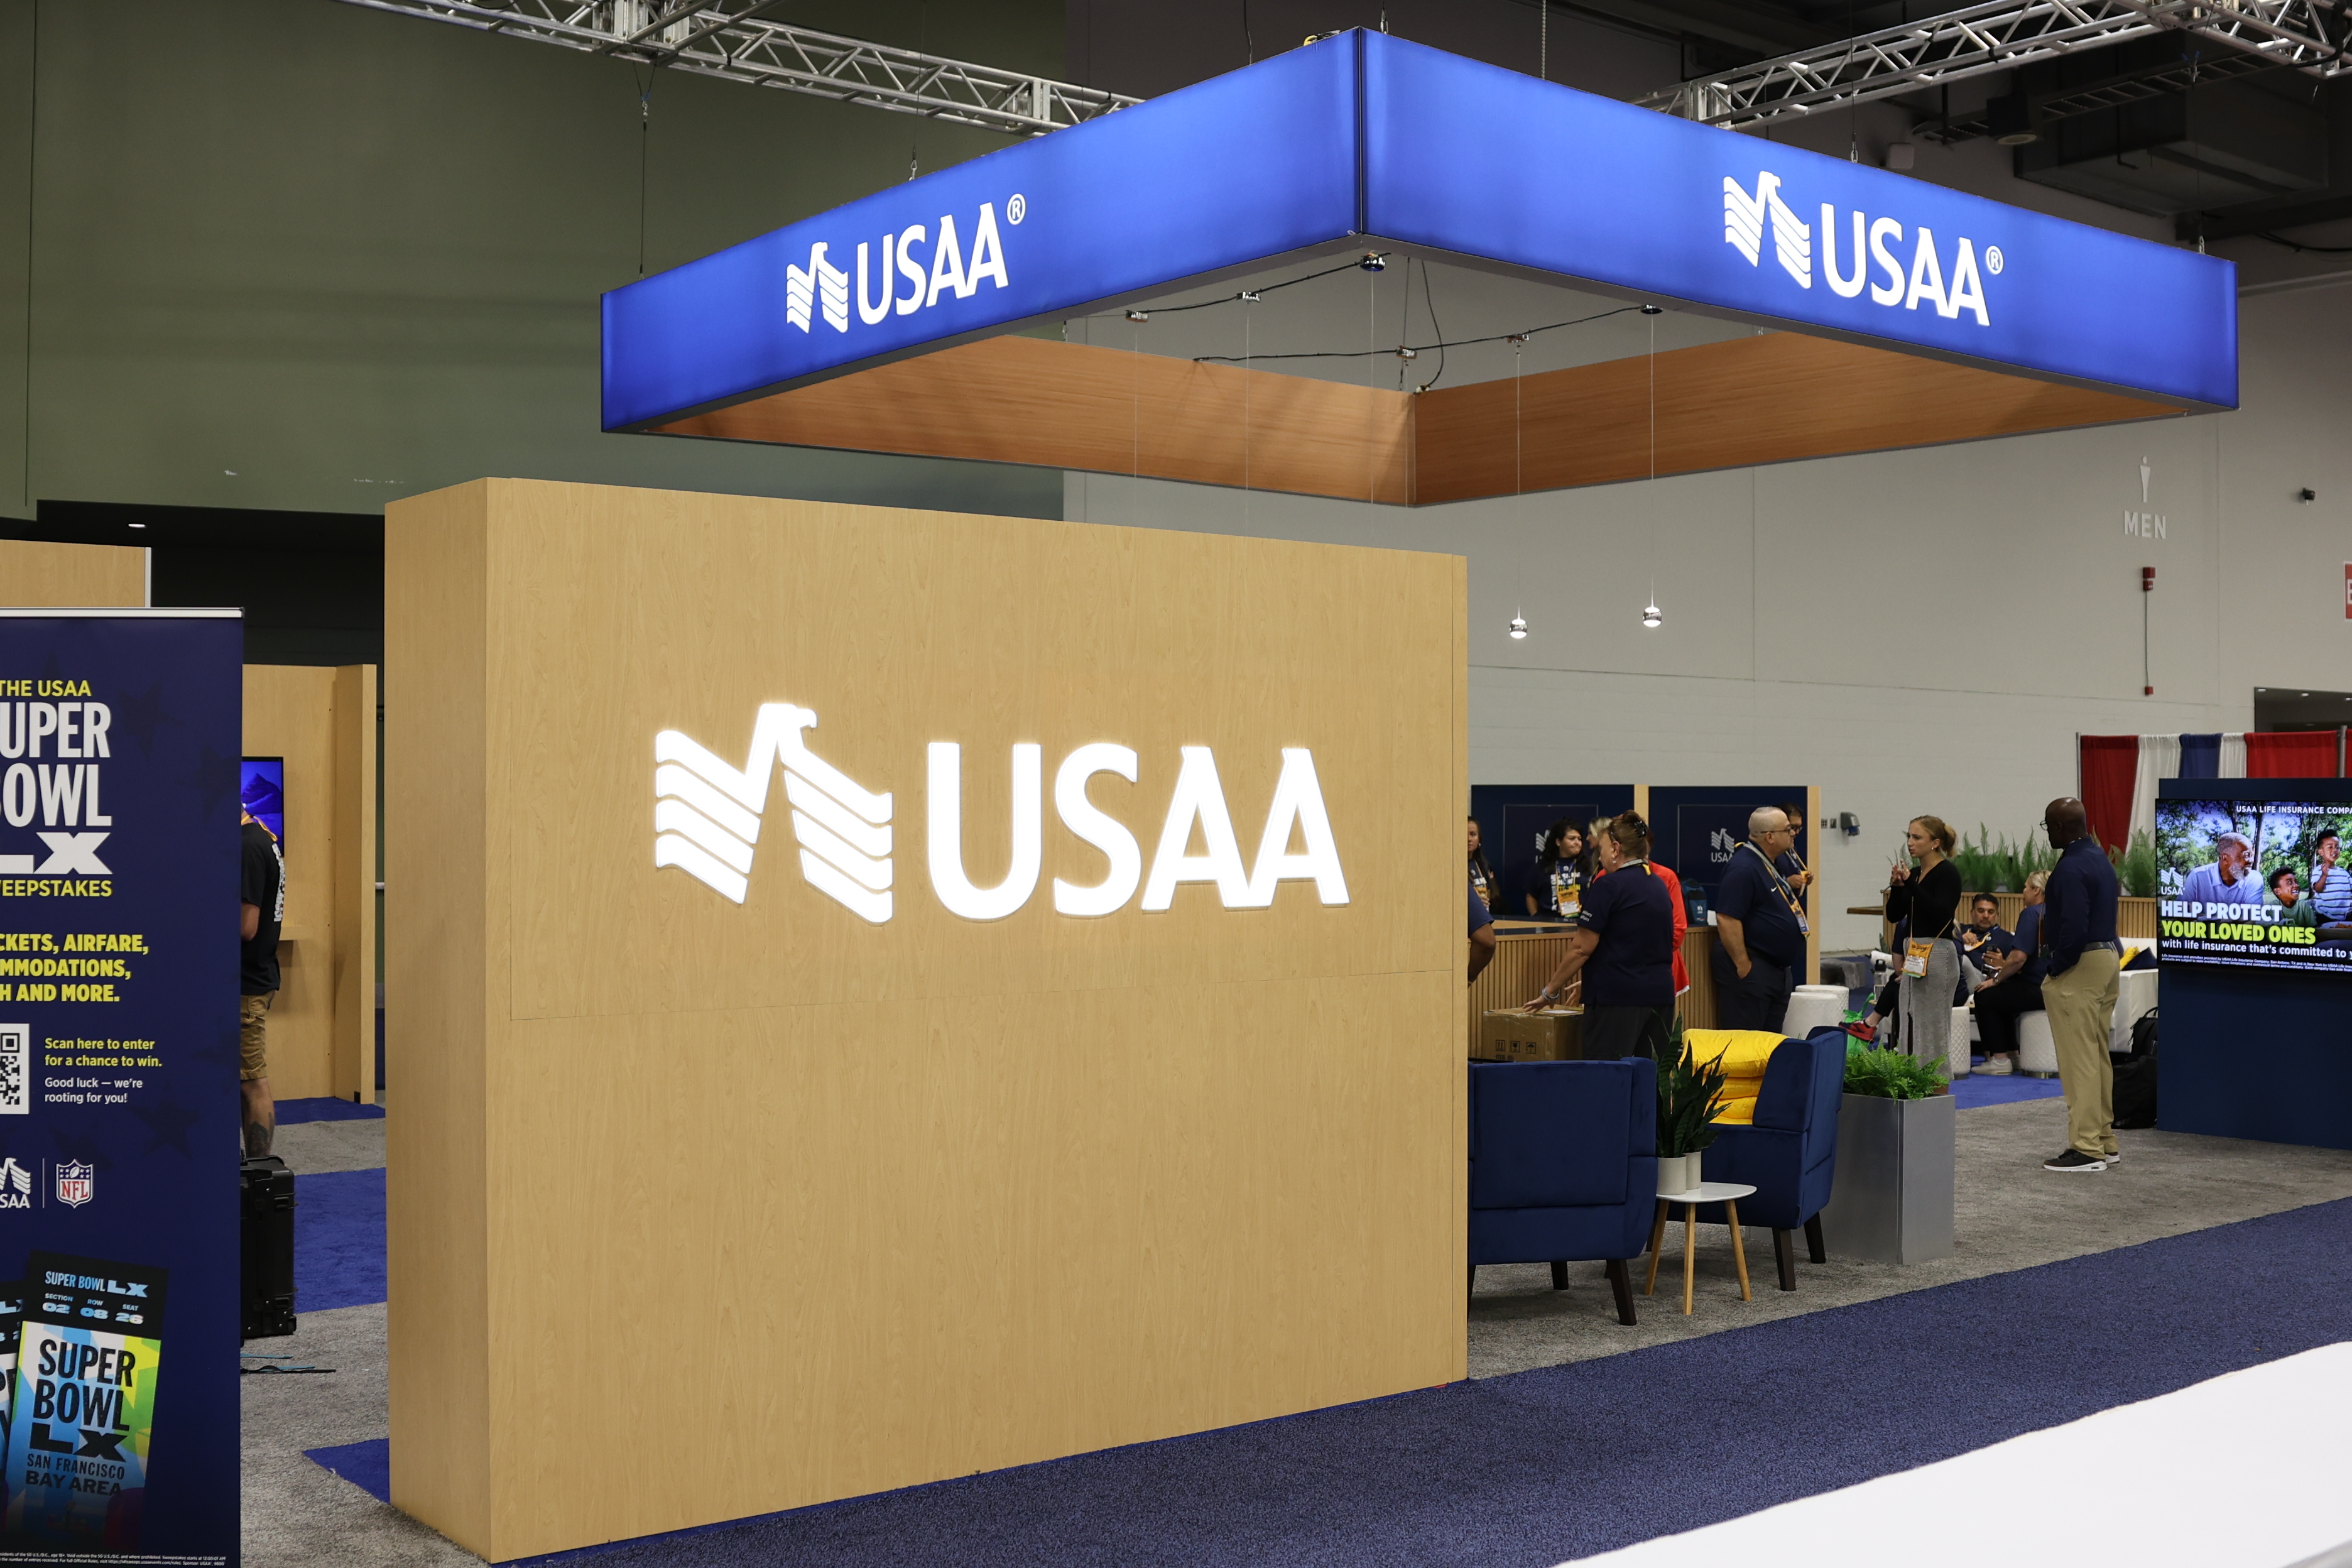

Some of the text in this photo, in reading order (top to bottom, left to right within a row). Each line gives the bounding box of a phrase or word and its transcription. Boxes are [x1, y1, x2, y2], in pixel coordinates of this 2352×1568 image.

[2124, 510, 2166, 539] MEN
[38, 680, 92, 697] USAA
[0, 763, 112, 827] OWL
[2278, 806, 2324, 814] INSURANCE
[927, 741, 1350, 920] USAA
[0, 880, 112, 897] EEPSTAKES
[2161, 900, 2282, 922] HELP PROTECT
[2162, 920, 2316, 944] YOUR LOVED ONES
[63, 934, 149, 955] AIRFARE,
[2162, 939, 2182, 949] with
[2184, 940, 2199, 949] life
[2202, 940, 2246, 952] insurance
[2279, 947, 2333, 957] committed
[2336, 949, 2346, 958] to
[16, 984, 57, 1001] AND
[61, 984, 120, 1002] MORE.
[45, 1038, 155, 1050] Scan here to enter
[45, 1054, 163, 1067] for a chance to win.
[45, 1077, 74, 1087] Good
[77, 1077, 99, 1087] luck
[45, 1092, 128, 1104] rooting for you!
[61, 1181, 89, 1200] NFL
[45, 1270, 149, 1298] SUPER BOWL LX
[45, 1293, 74, 1302] SECTION
[42, 1302, 144, 1325] 02 08 26
[38, 1339, 136, 1388] SUPER
[33, 1378, 131, 1432] BOWL
[29, 1422, 128, 1463] LX
[27, 1453, 125, 1480] SAN FRANCISCO
[25, 1470, 122, 1497] BAY AREA
